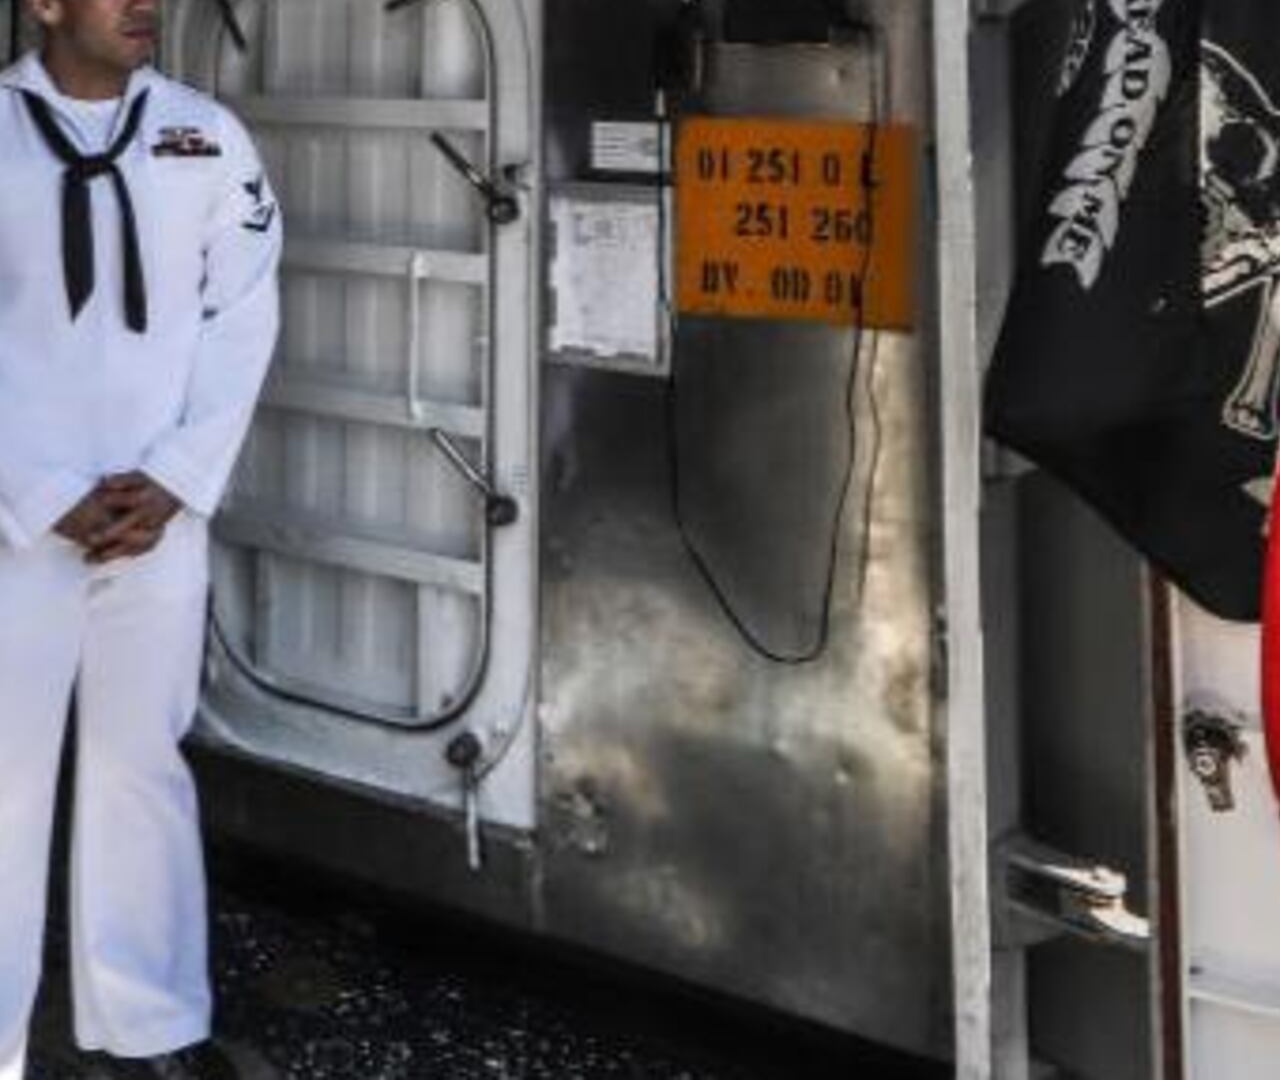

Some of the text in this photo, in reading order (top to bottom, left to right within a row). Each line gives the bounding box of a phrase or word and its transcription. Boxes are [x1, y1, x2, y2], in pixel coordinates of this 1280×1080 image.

[747, 148, 800, 186] 251
[1094, 118, 1135, 182] ON
[736, 203, 788, 240] 251
